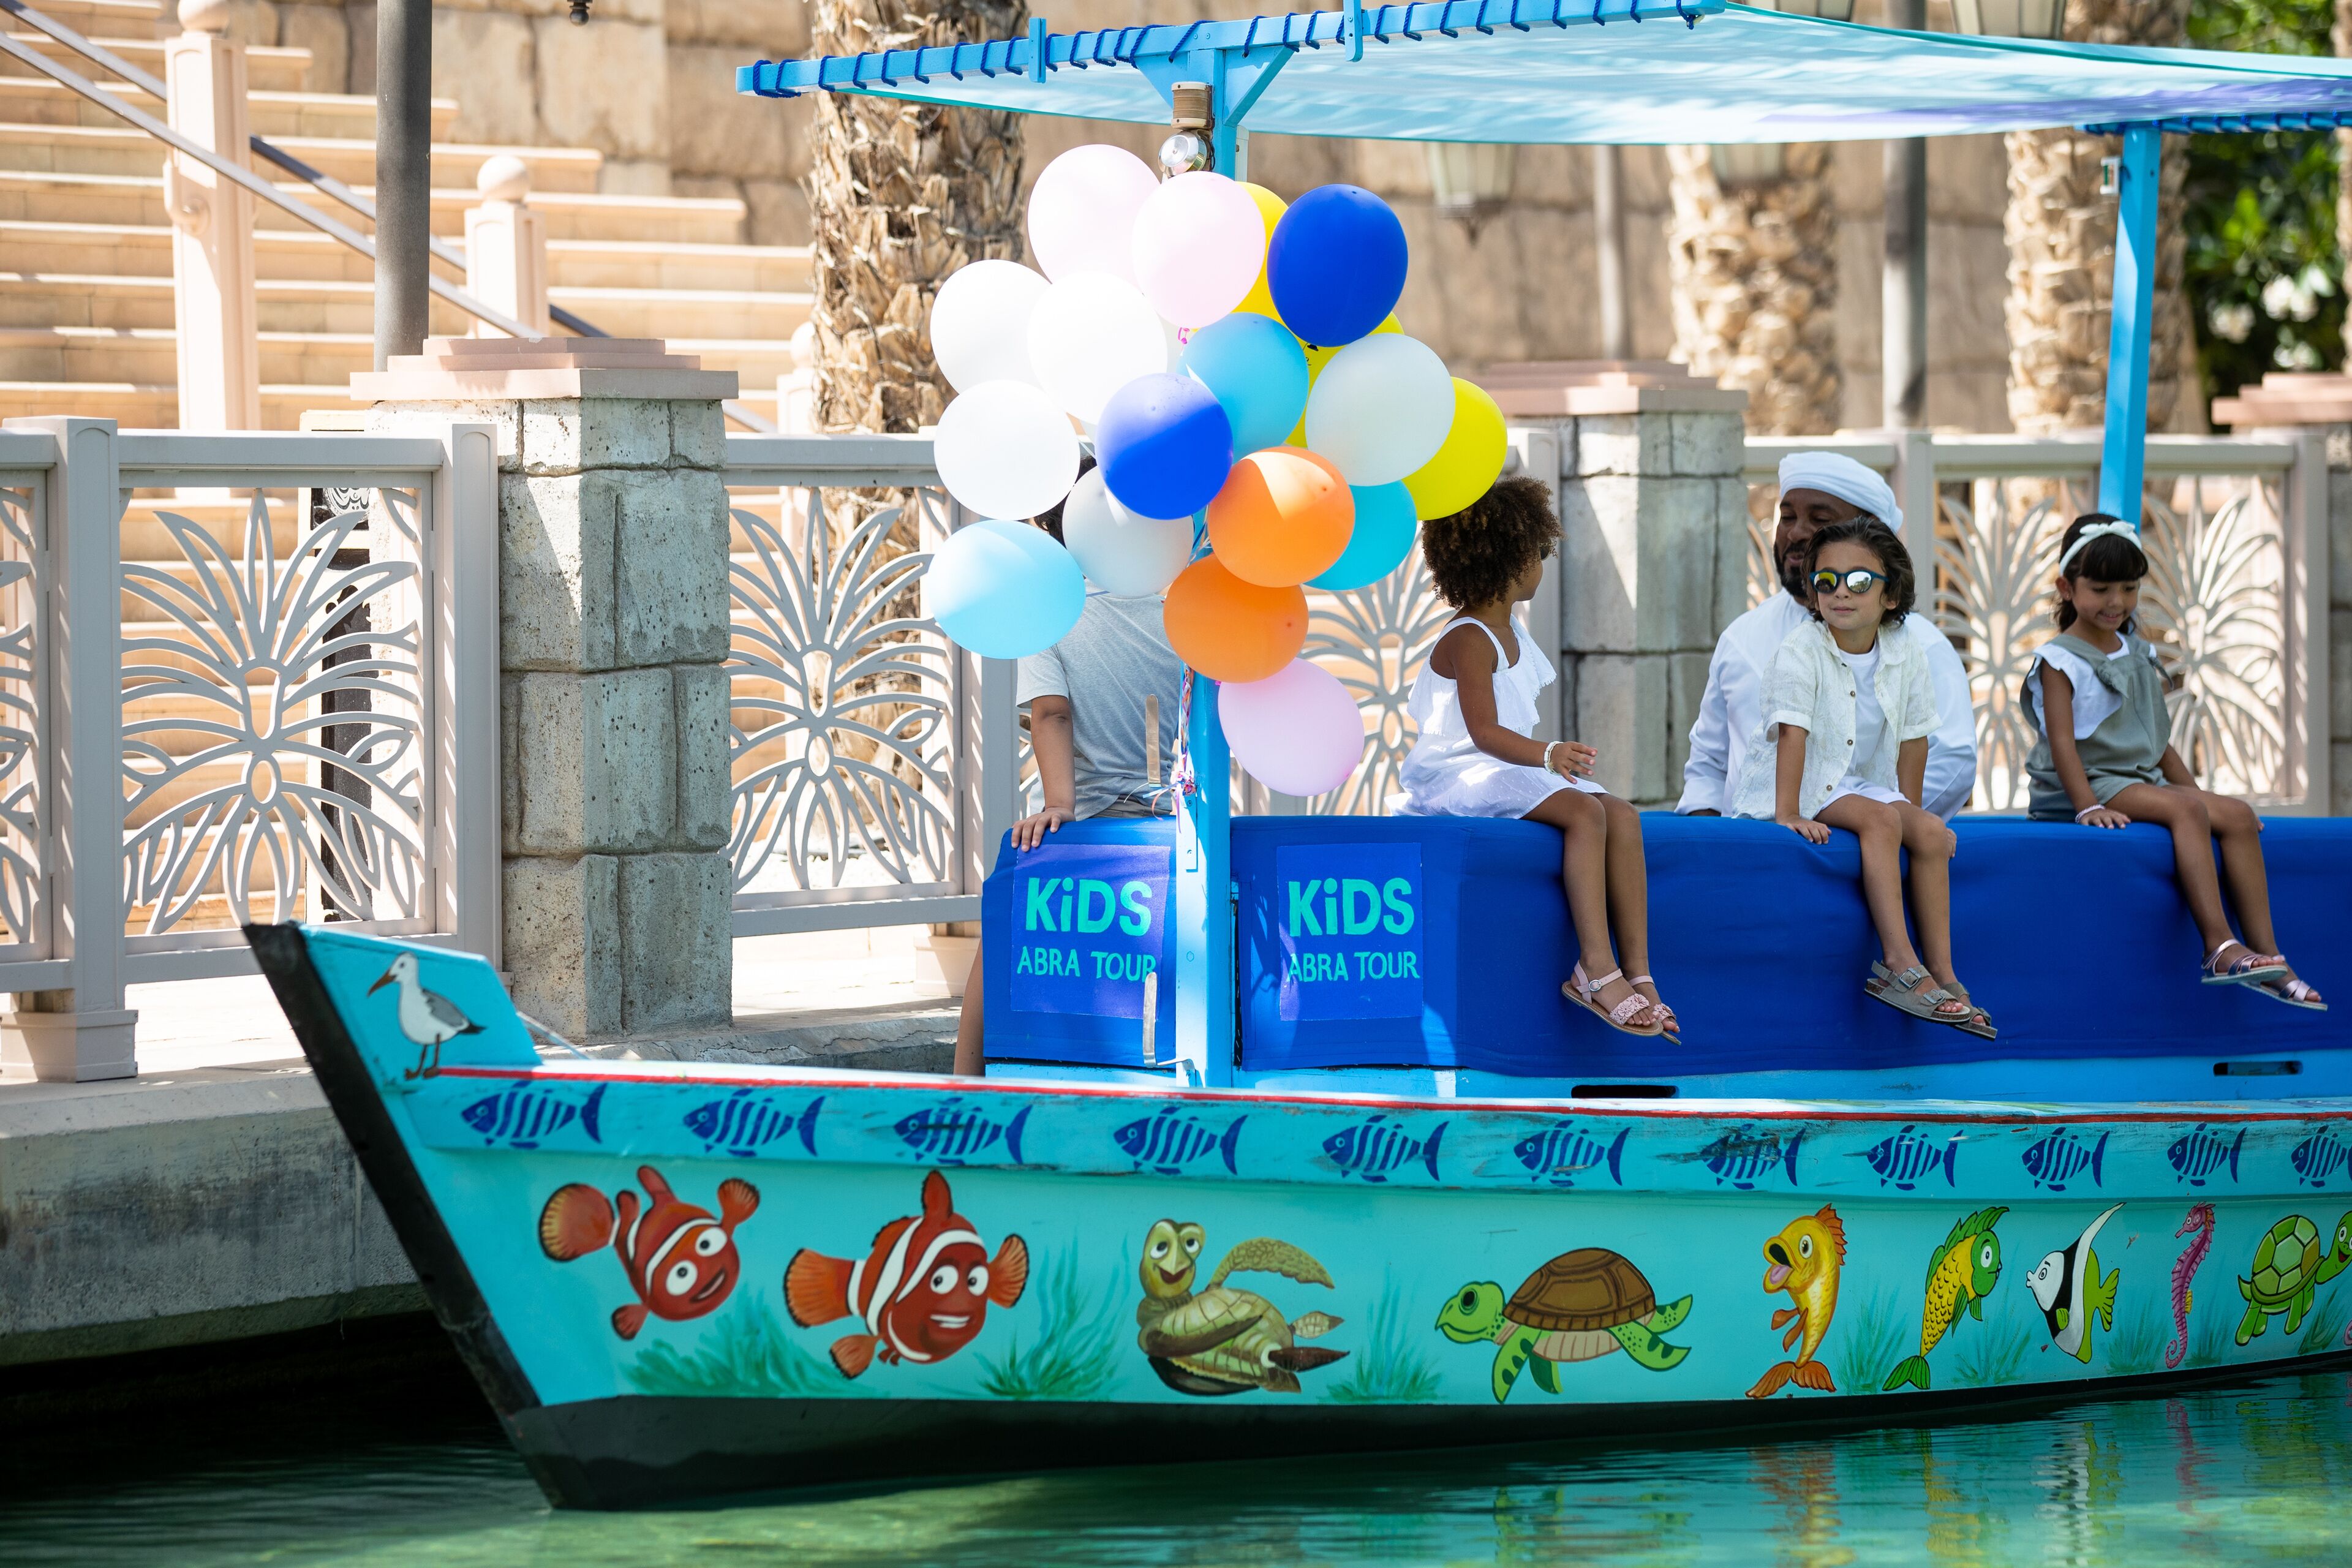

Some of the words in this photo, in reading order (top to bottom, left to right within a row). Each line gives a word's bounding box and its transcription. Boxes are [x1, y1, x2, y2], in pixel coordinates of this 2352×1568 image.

[1025, 876, 1155, 937] KiDS
[1288, 877, 1415, 937] KiDS
[1017, 946, 1080, 977] ABRA
[1090, 951, 1156, 983] TOUR
[1286, 952, 1349, 982] ABRA
[1354, 951, 1420, 981] TOUR
